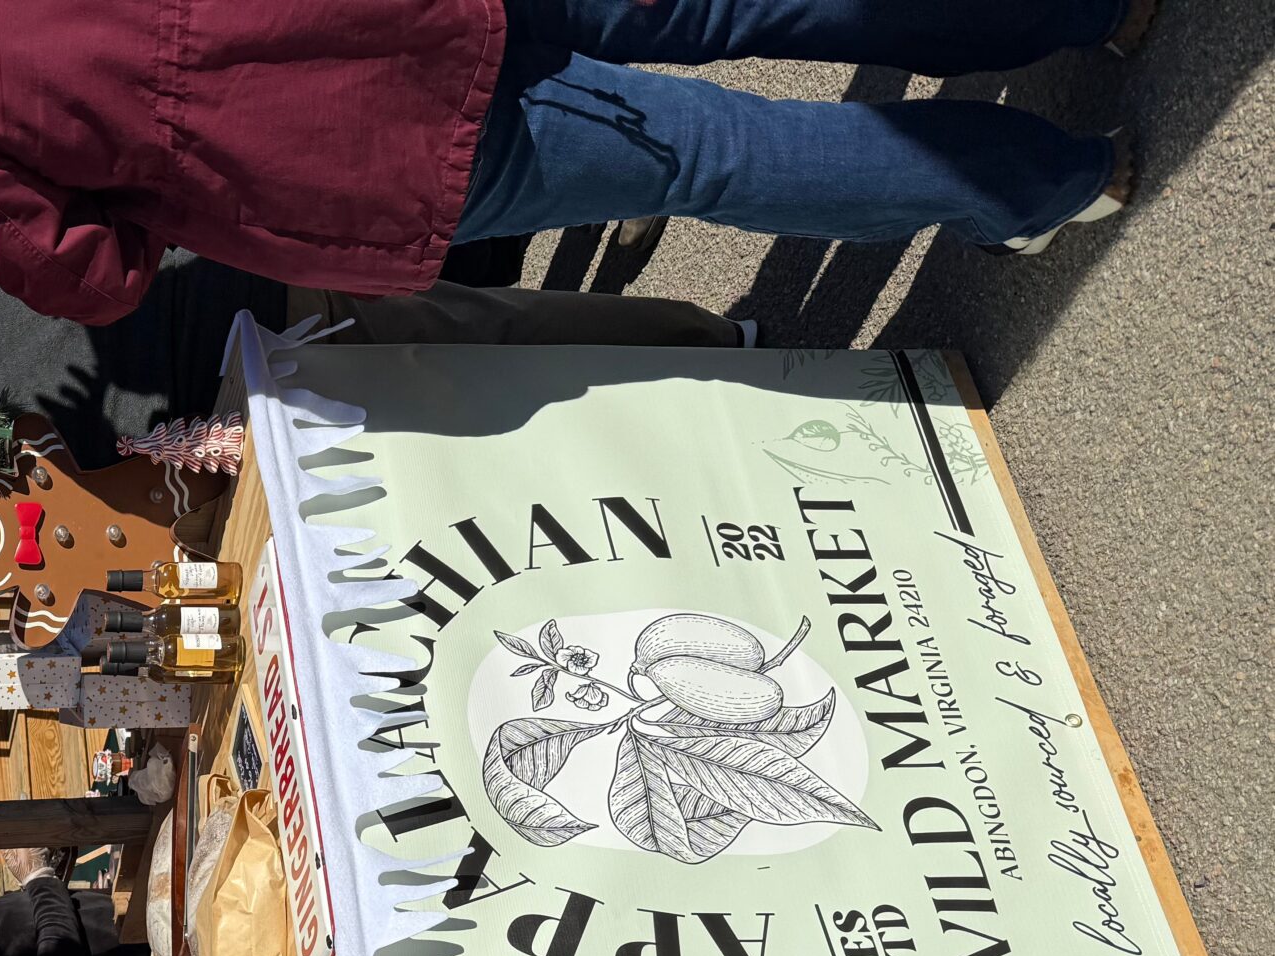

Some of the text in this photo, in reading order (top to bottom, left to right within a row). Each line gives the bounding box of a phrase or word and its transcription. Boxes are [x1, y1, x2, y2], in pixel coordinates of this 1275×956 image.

[252, 566, 275, 656] ST.
[715, 522, 752, 561] 20
[746, 523, 786, 562] 22
[793, 486, 946, 771] MARKET
[891, 568, 1023, 882] ABINGDON, VIRGINIA 24210
[933, 531, 1143, 956] locally sourced & foraged
